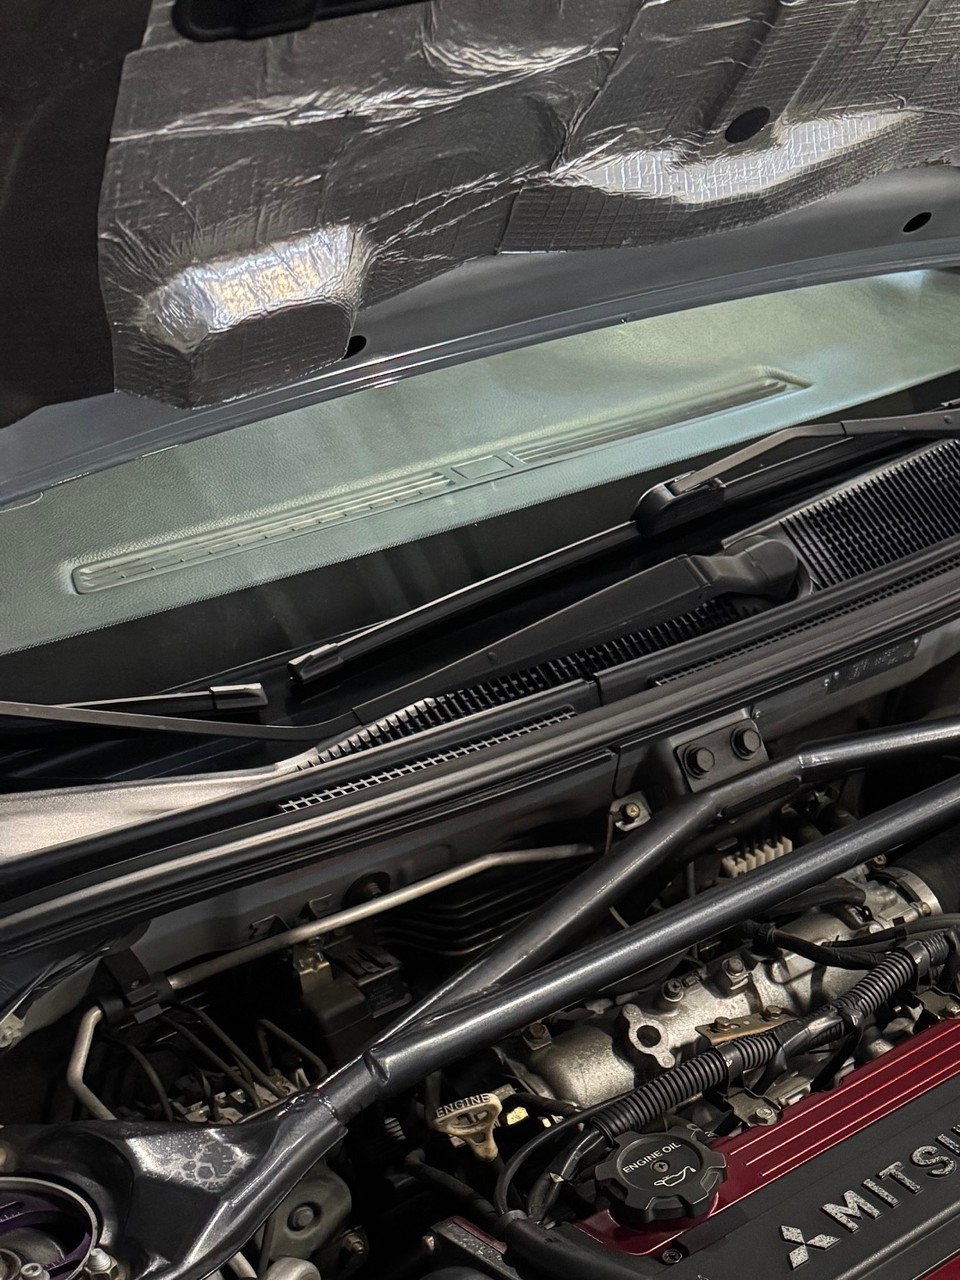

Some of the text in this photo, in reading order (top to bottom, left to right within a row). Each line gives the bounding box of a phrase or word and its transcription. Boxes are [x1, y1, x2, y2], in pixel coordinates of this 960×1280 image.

[434, 1093, 492, 1118] ENGINE
[622, 1141, 682, 1174] ENGINE OIL
